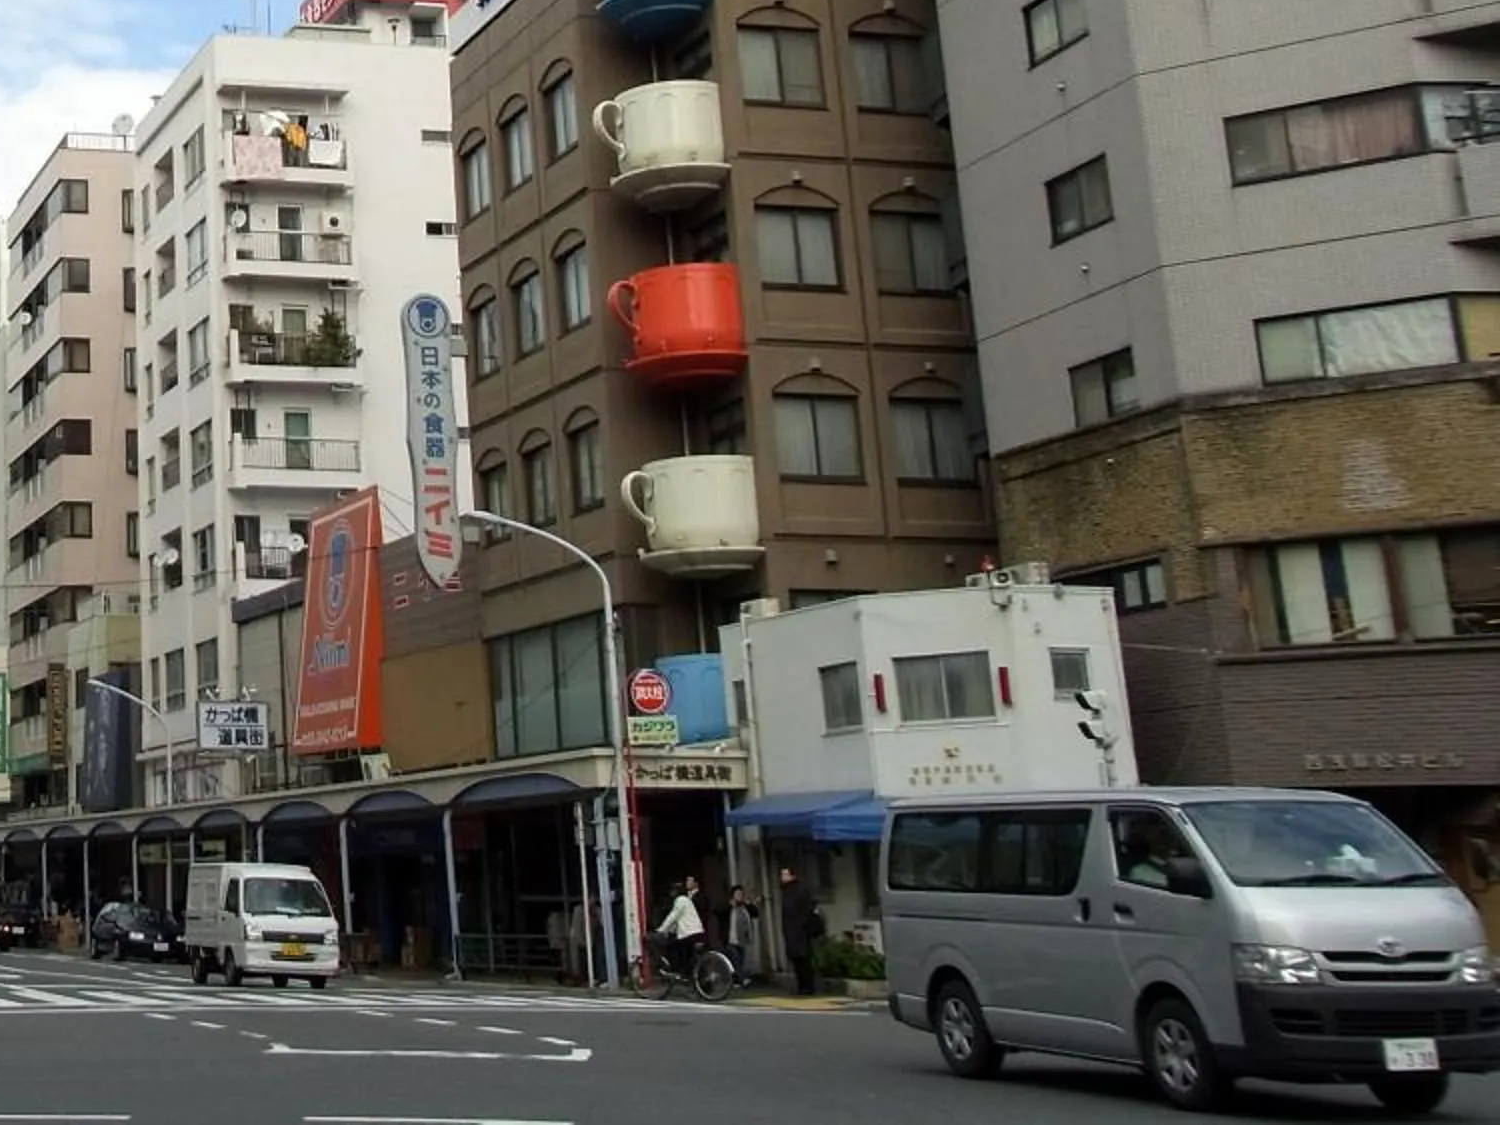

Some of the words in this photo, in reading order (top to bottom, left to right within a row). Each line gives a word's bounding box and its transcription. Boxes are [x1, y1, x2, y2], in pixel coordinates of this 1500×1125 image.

[420, 346, 446, 458] 日本の食器
[424, 467, 453, 559] ニイミ
